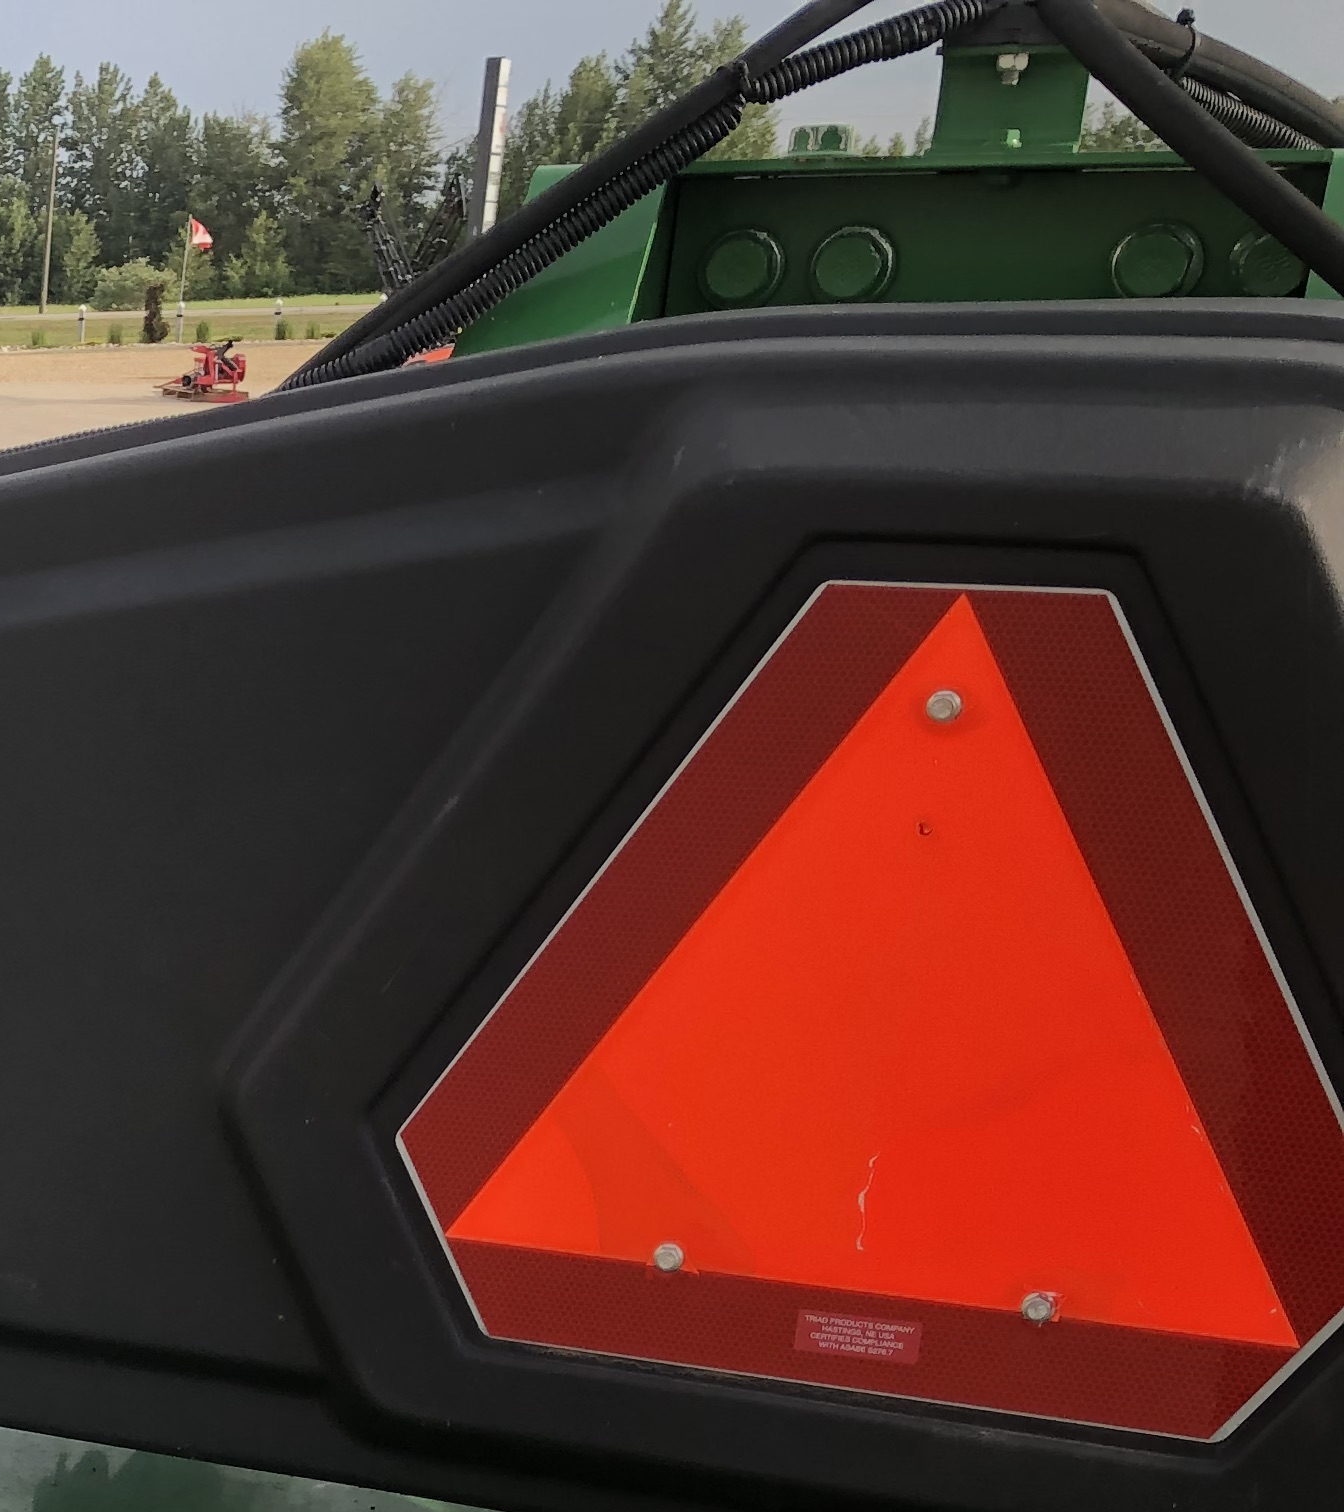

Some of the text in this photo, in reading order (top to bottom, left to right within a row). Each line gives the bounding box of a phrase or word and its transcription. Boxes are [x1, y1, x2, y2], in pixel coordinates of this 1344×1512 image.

[805, 1315, 915, 1334] TRIAD PRODUCTS COMPANY
[822, 1325, 863, 1337] HASTINGS,
[878, 1332, 894, 1340] USA
[819, 1342, 838, 1350] WITH
[852, 1337, 904, 1350] COMPLIANCE
